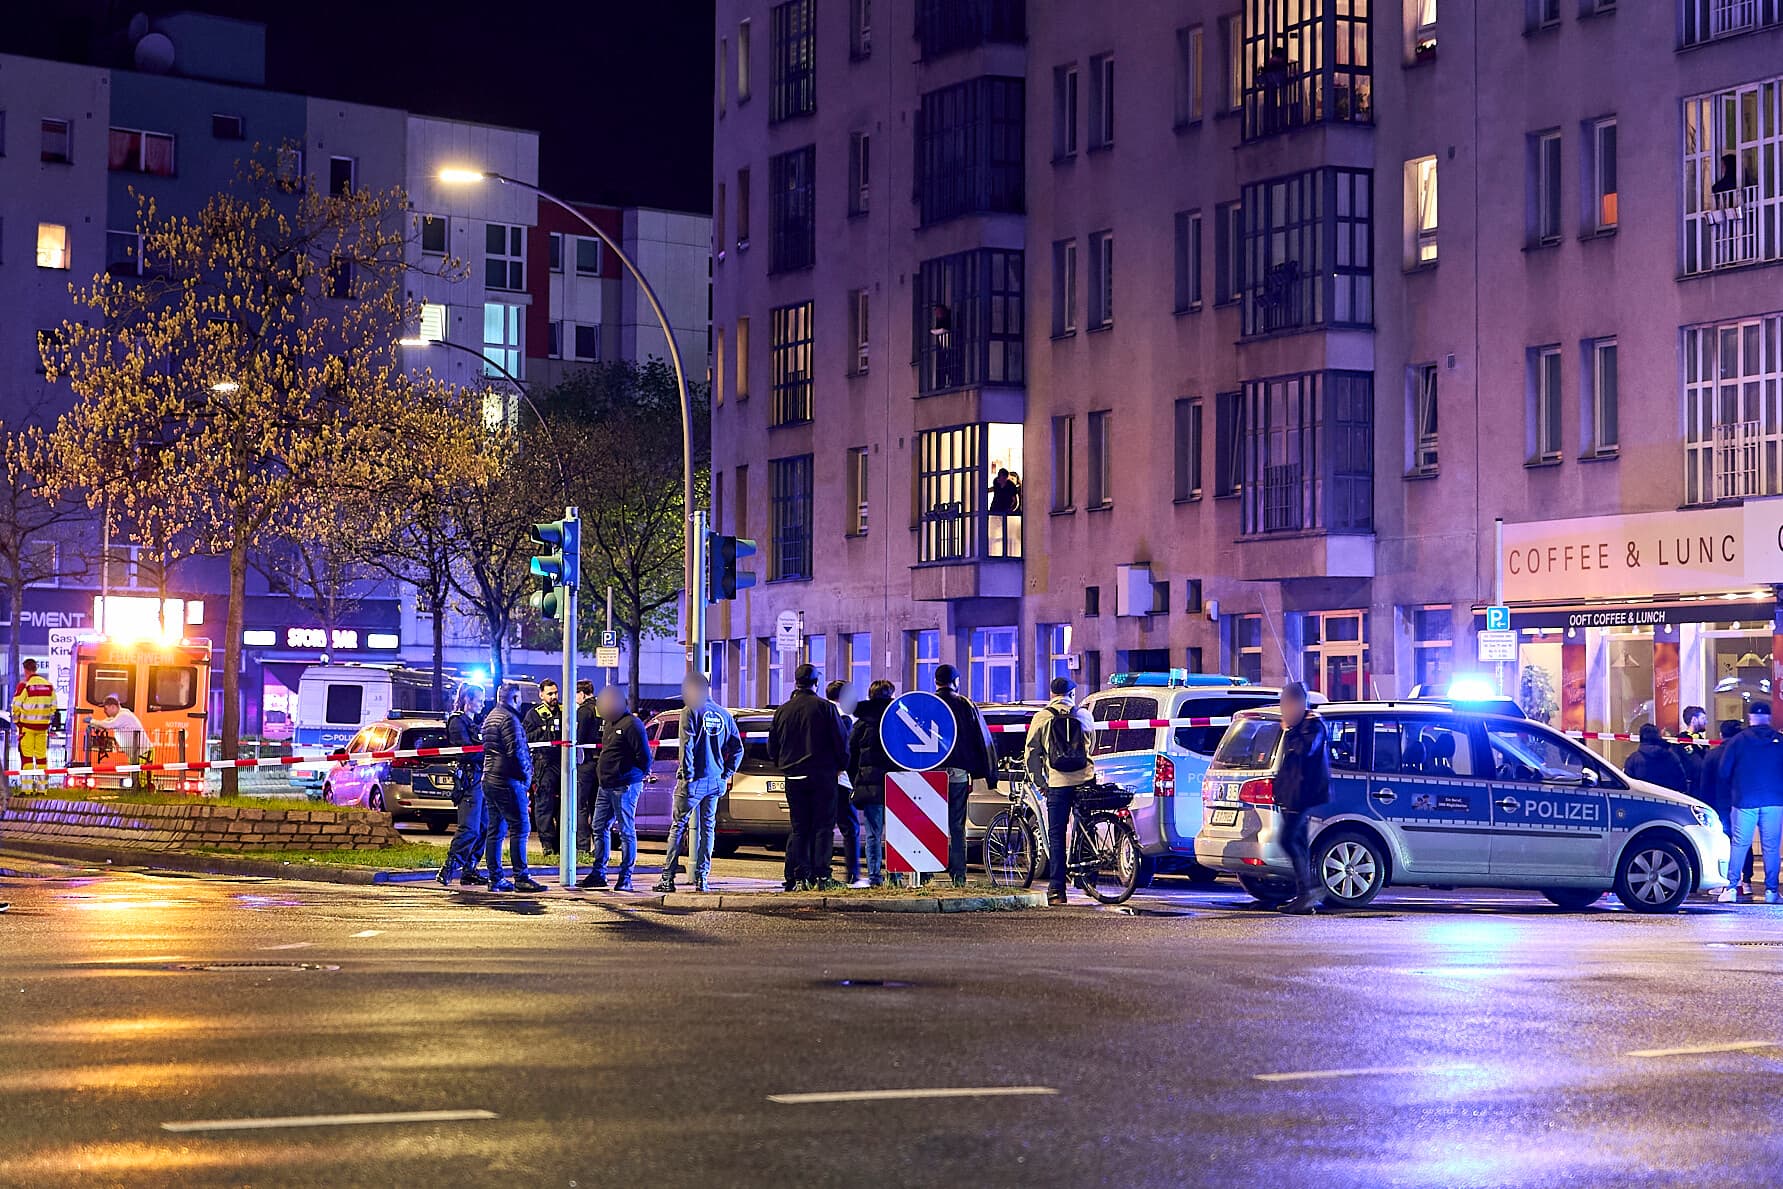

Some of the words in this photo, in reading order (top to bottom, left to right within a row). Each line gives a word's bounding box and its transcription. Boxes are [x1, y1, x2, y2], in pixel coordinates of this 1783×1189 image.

[1509, 543, 1609, 575] COFFEE
[1626, 540, 1641, 568] &
[1658, 534, 1736, 566] LUNC
[1491, 609, 1503, 628] P
[1569, 614, 1592, 626] OOFT
[1593, 612, 1626, 625] COFFEE
[1628, 612, 1634, 623] &
[1636, 610, 1665, 623] LUNCH
[603, 632, 612, 645] P
[1525, 800, 1599, 821] POLIZEI
